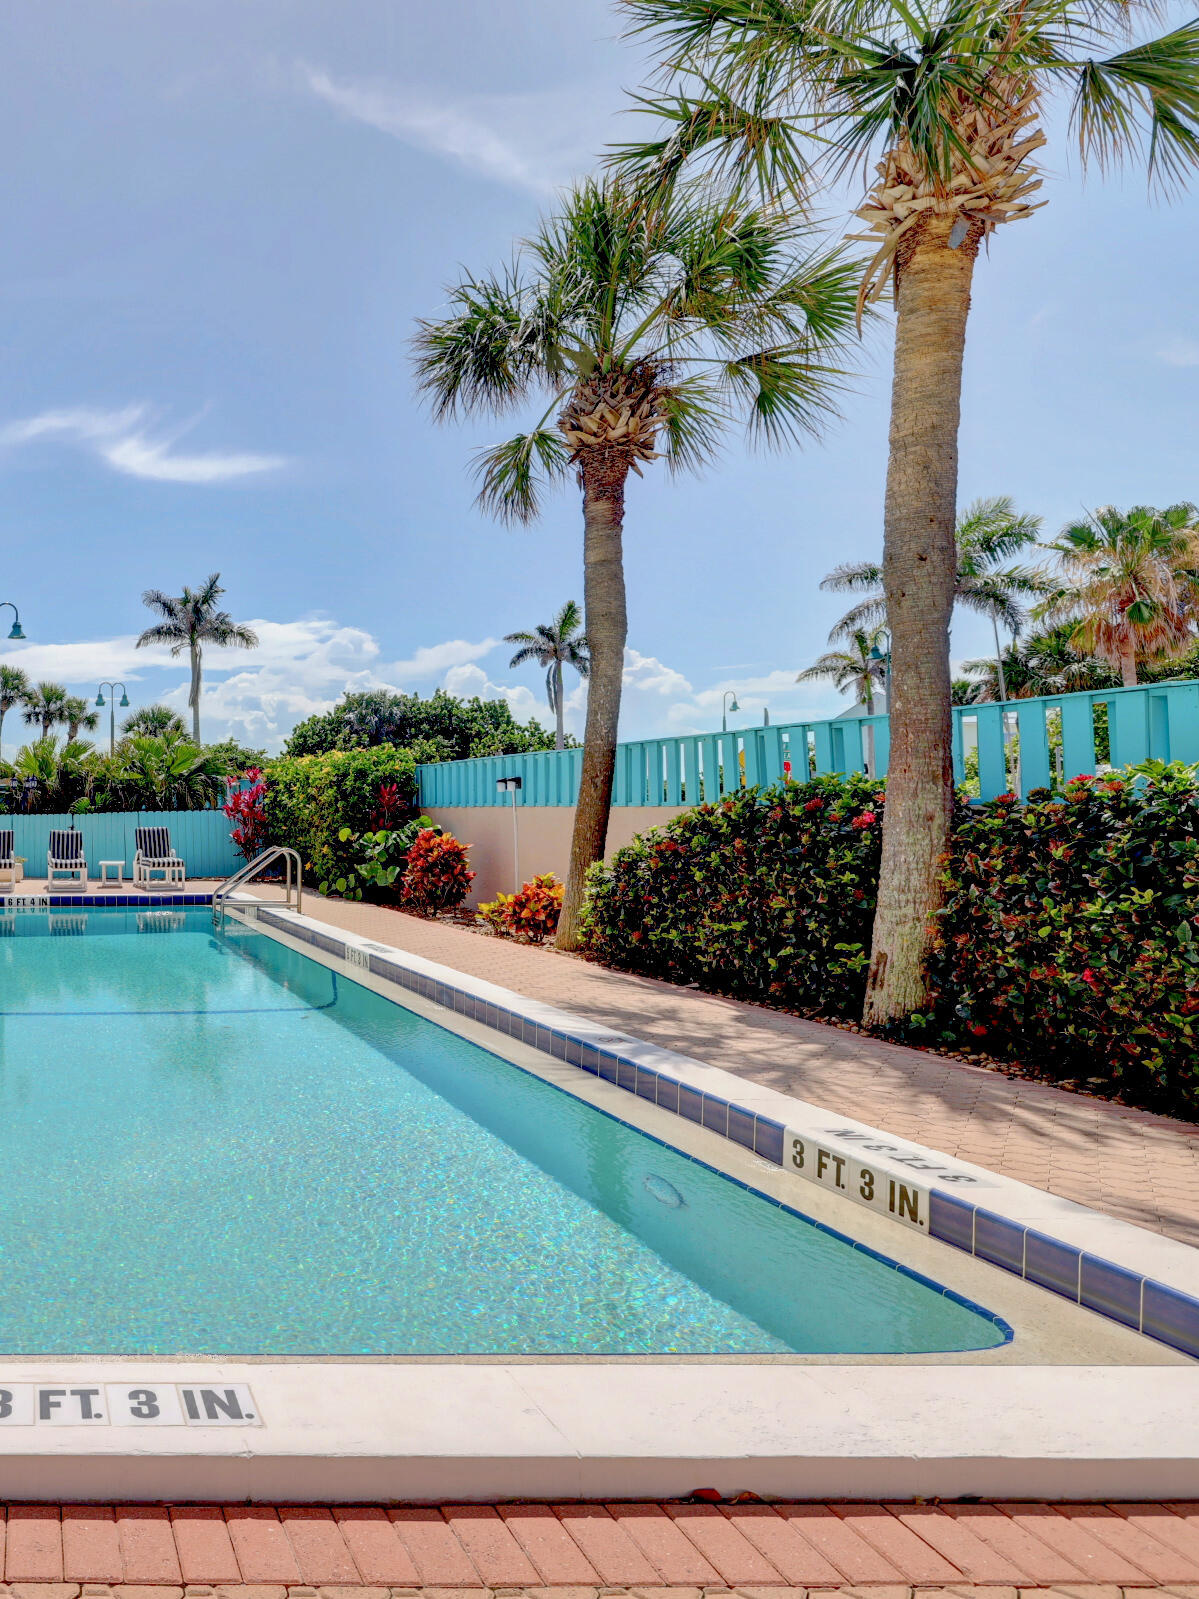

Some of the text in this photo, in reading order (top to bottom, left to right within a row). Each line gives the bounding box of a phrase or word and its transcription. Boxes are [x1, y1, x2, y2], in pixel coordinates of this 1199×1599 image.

[792, 1139, 924, 1226] 3 FT. 3 IN.
[39, 1389, 103, 1420] FT.
[129, 1389, 160, 1419] 3
[182, 1389, 254, 1420] IN.
